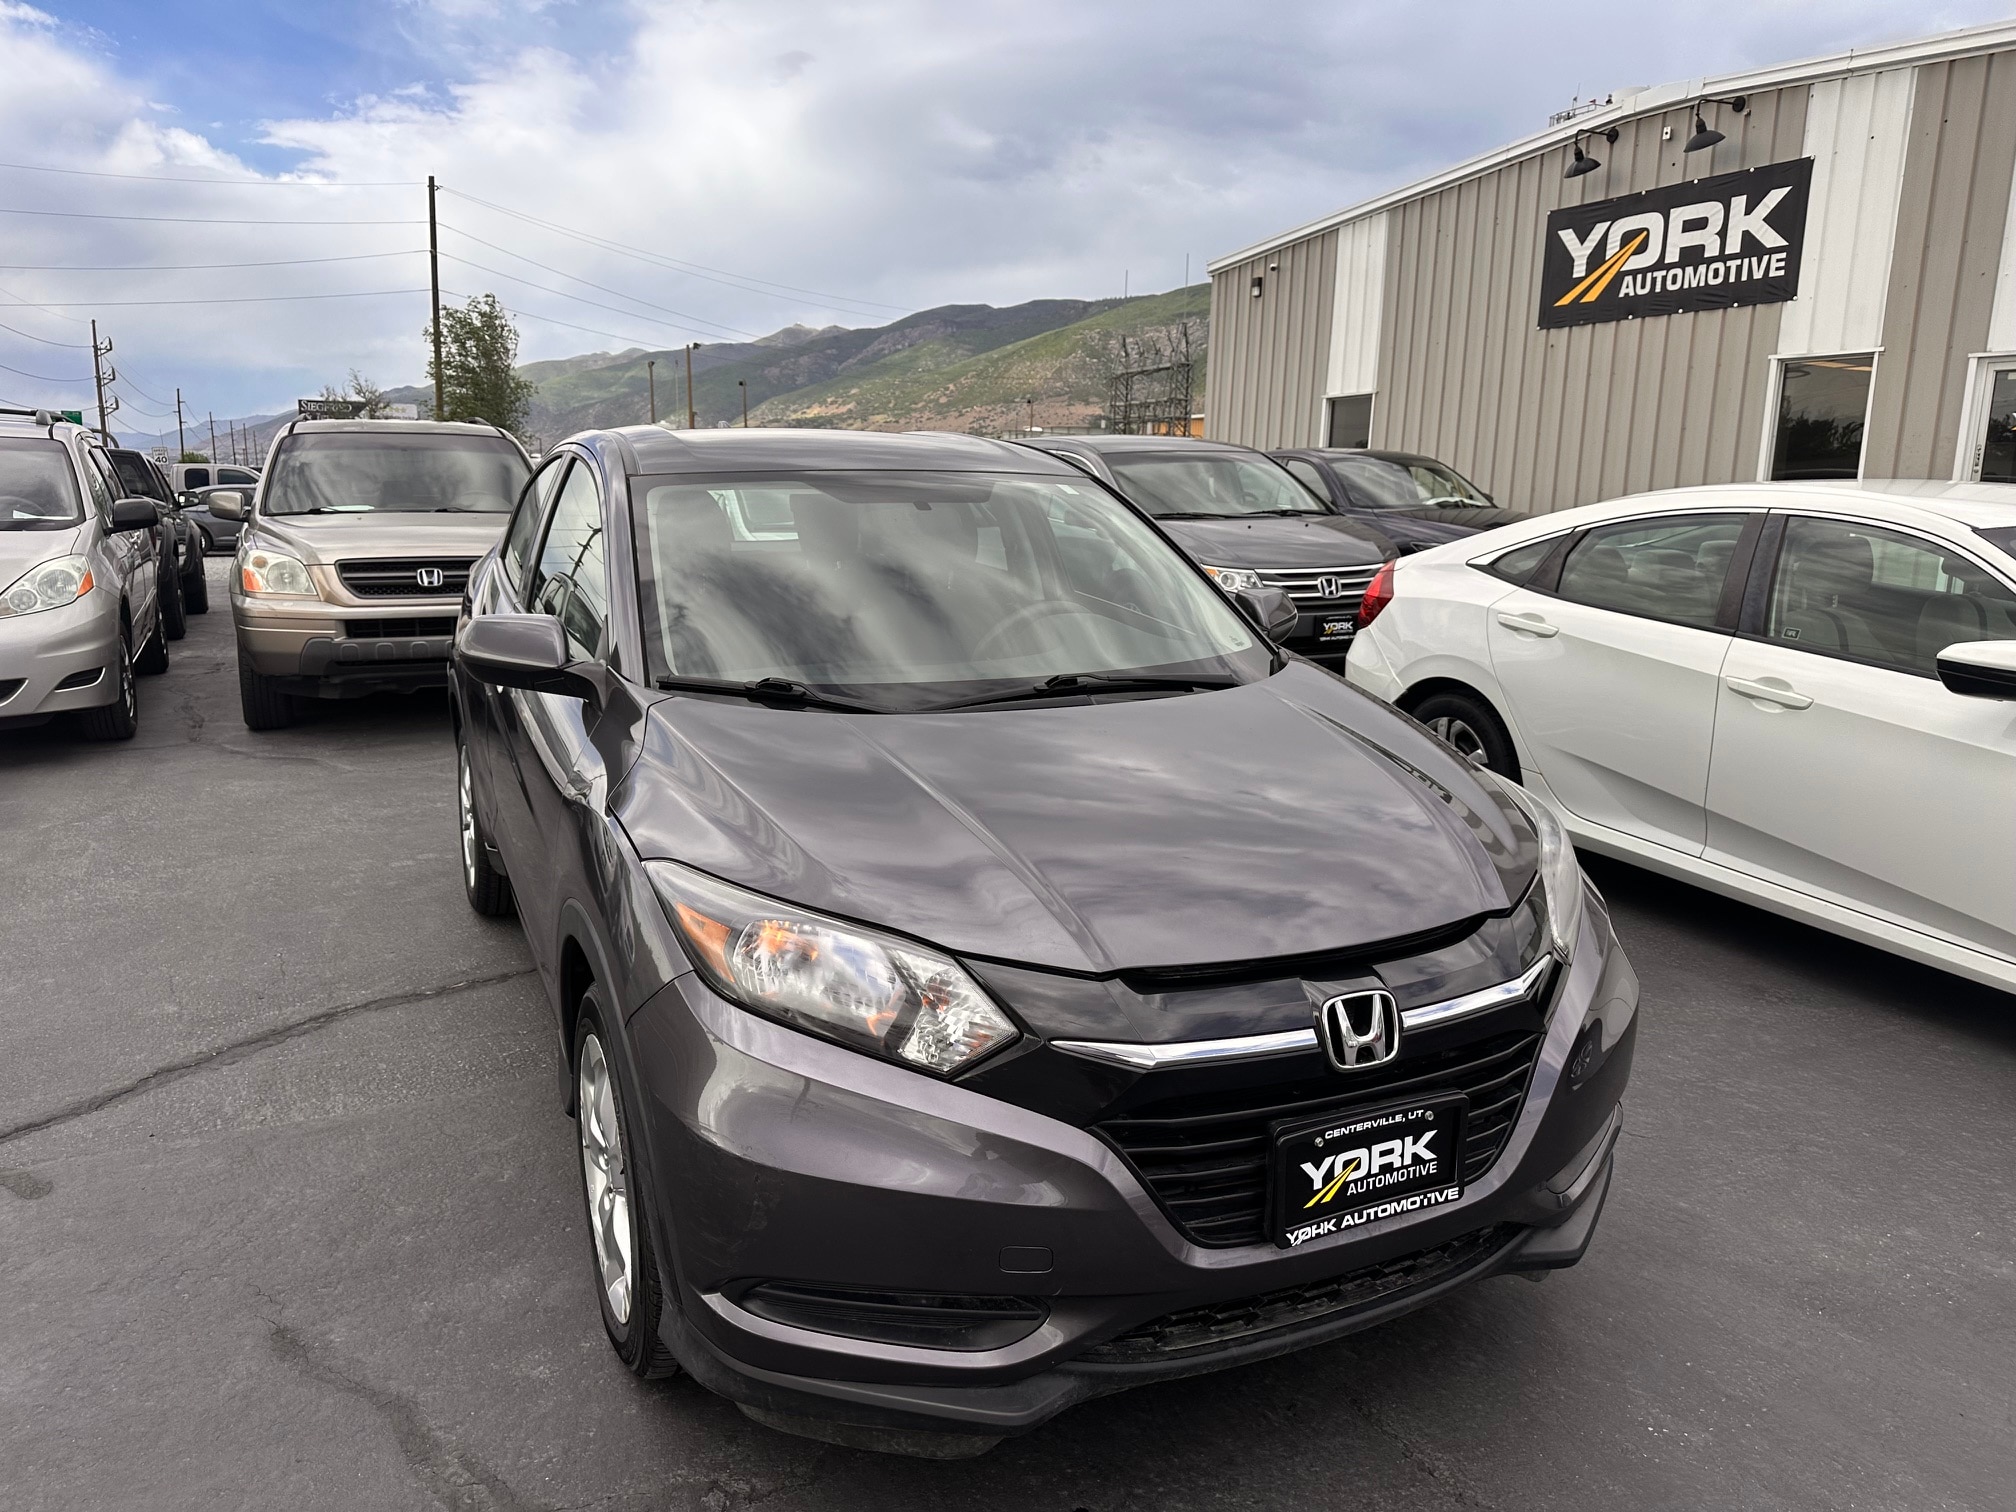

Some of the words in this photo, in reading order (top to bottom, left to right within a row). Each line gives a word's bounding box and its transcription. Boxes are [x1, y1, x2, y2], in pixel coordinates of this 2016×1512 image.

[1557, 185, 1793, 278] YORK
[1618, 252, 1787, 298] AUTOMOTIVE
[1323, 621, 1354, 630] YORK
[1325, 1113, 1405, 1140] CENTERVILLE,
[1408, 1110, 1424, 1119] UT
[1300, 1129, 1438, 1190] YORK
[1347, 1161, 1438, 1196] AUTOMOTIVE
[1341, 1187, 1459, 1229] AUTOMOTIVE
